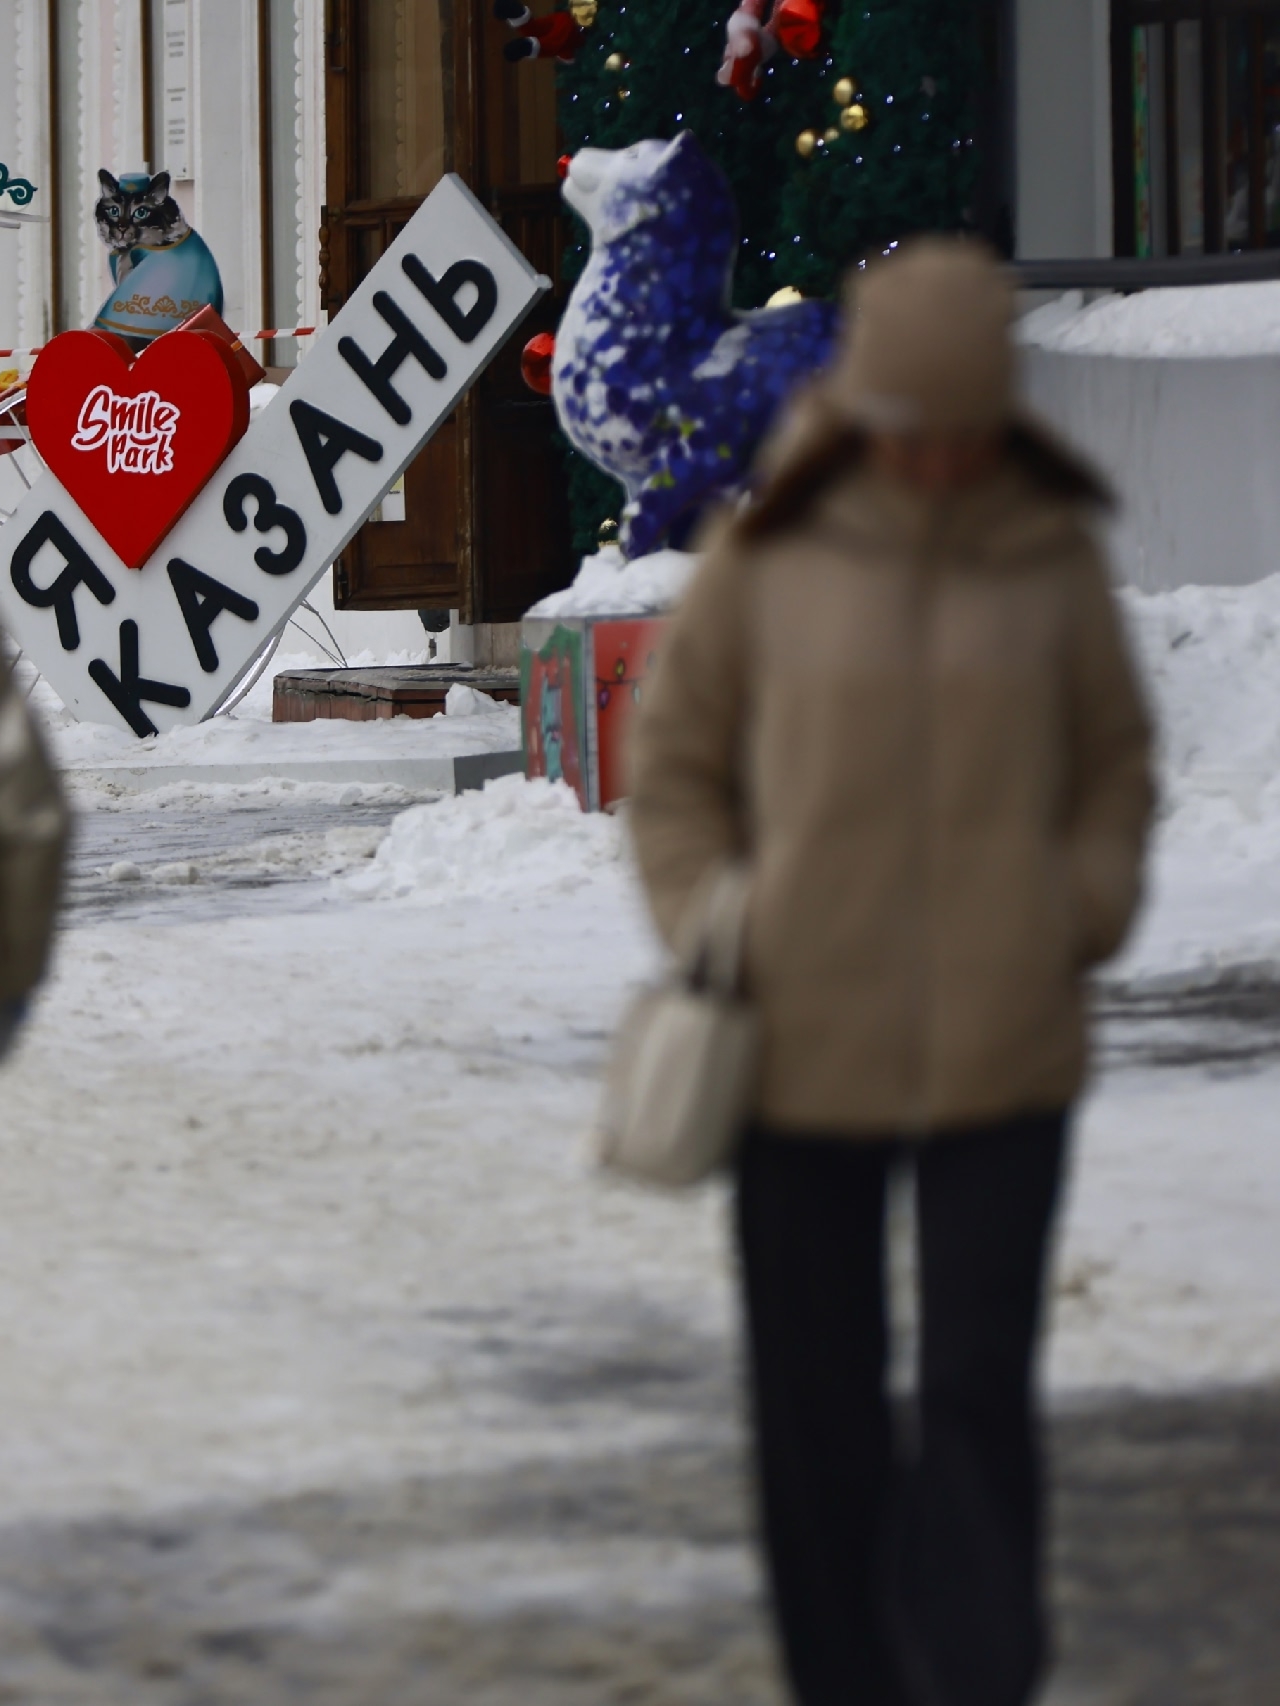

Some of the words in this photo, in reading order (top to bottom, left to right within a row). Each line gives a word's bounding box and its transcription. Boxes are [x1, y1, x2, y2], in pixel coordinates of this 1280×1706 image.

[73, 387, 179, 448] Smile
[108, 433, 173, 472] Park
[87, 253, 498, 738] КАЗАНЬ
[9, 510, 116, 651] Я
